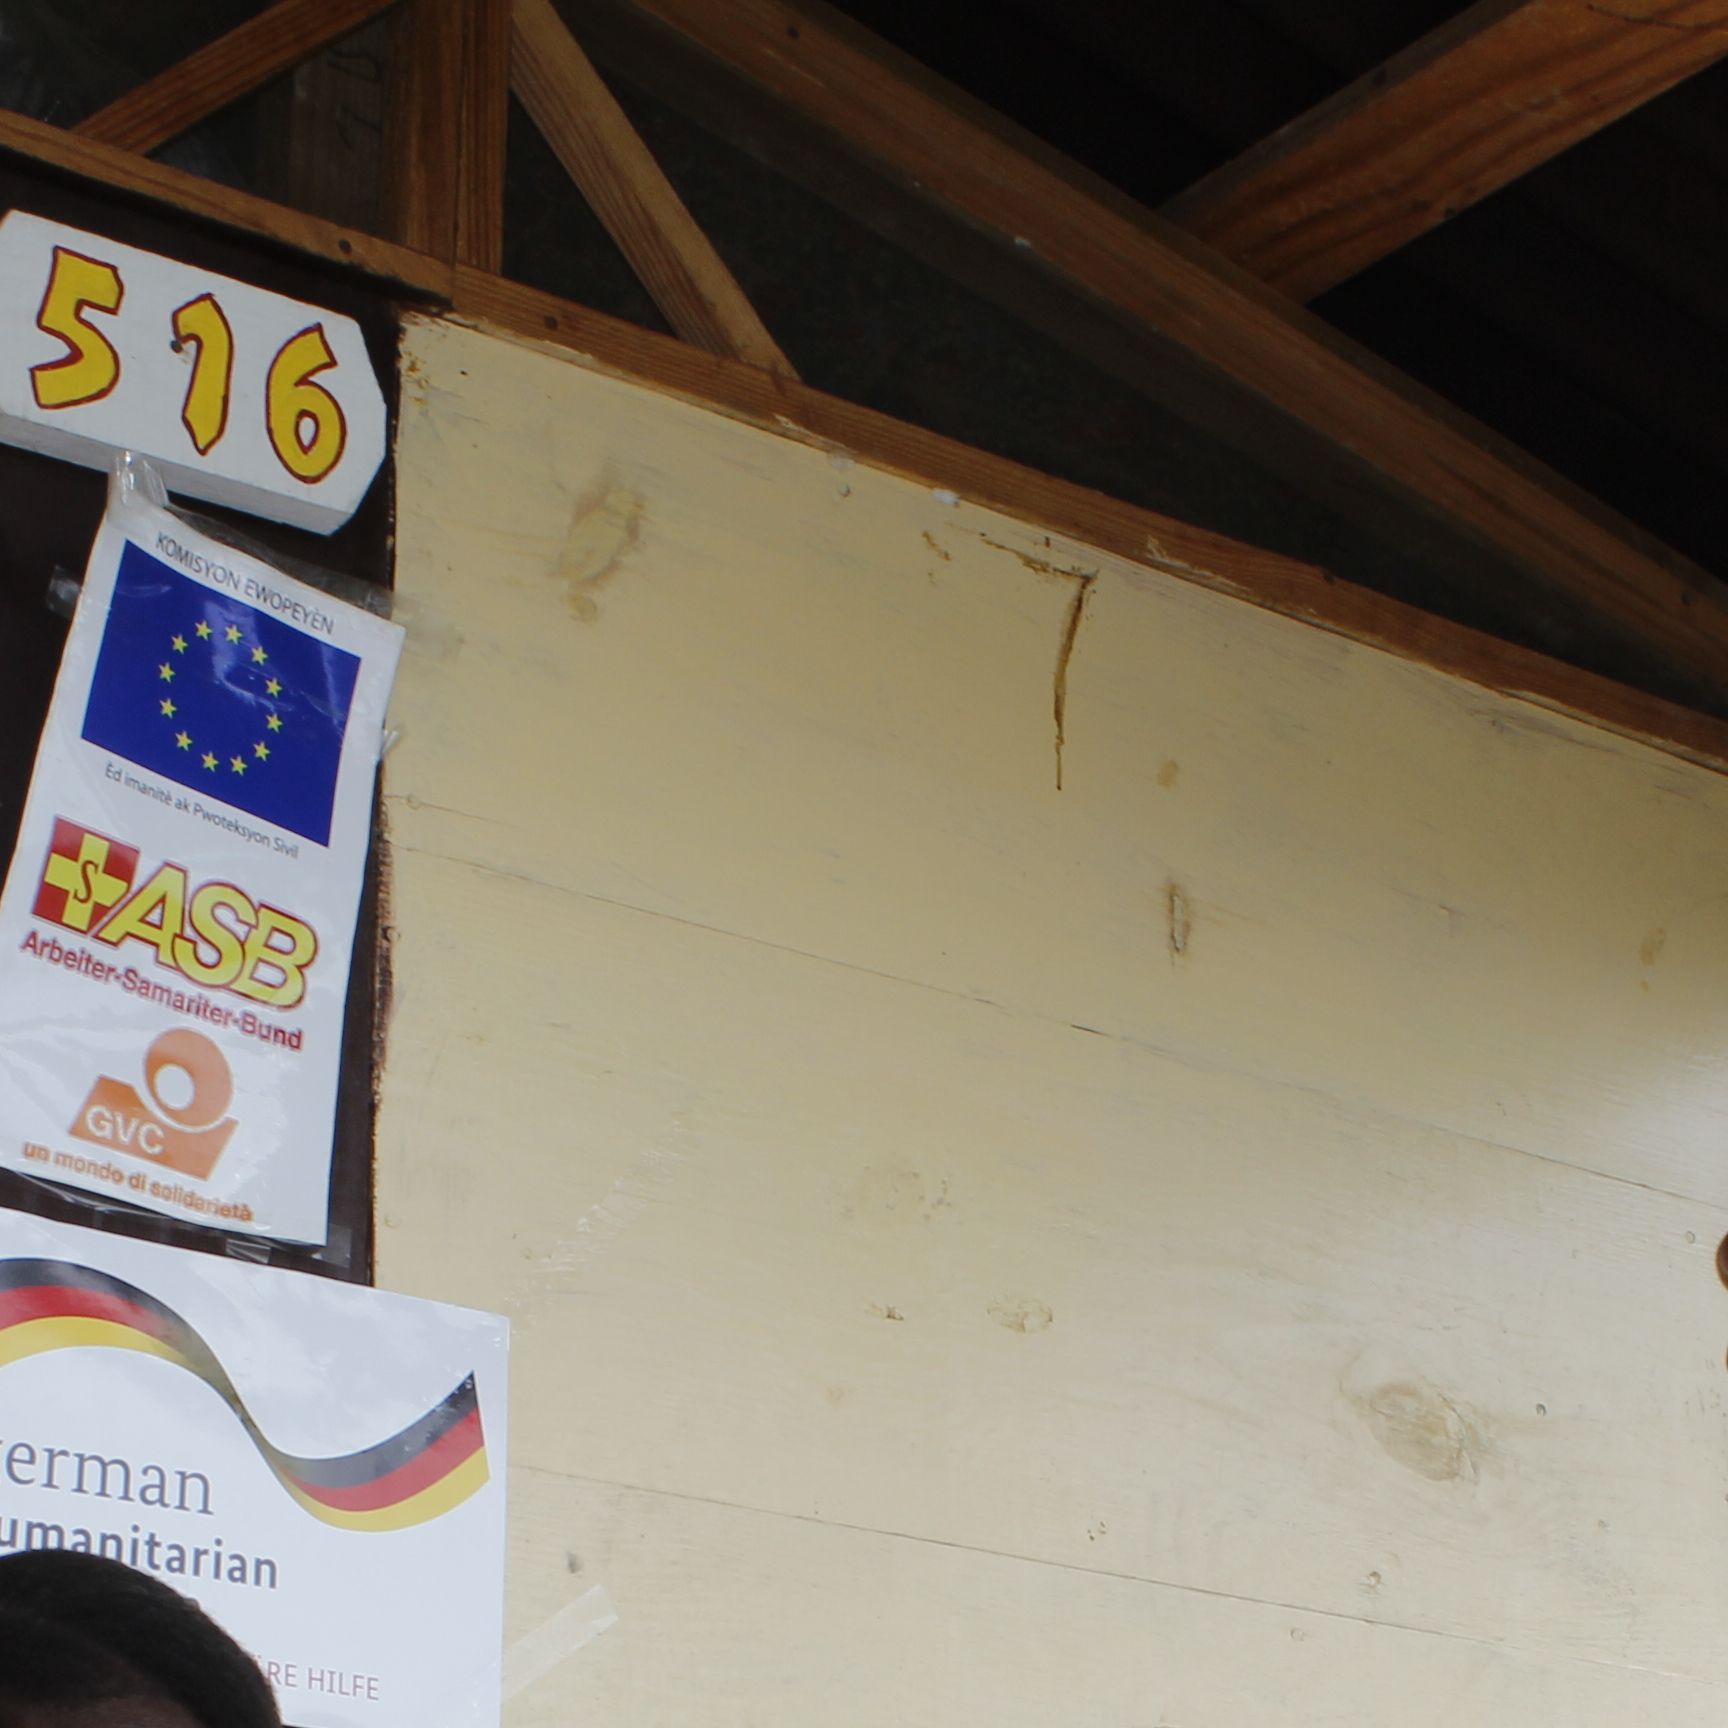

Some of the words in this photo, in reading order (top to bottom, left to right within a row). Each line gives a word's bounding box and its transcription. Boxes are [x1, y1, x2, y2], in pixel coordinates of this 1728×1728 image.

[29, 245, 348, 484] 516
[155, 531, 241, 591] KOMISYON
[174, 797, 191, 815] ak
[193, 802, 271, 848] Pwoteksyon
[273, 837, 300, 860] Sivil
[90, 861, 319, 1011] ASB
[20, 929, 304, 1051] Arbeiter-Samariter-Bund
[85, 1103, 165, 1156] GVC
[24, 1141, 50, 1163] un
[53, 1150, 124, 1185] mondo
[129, 1171, 146, 1191] di
[308, 1667, 379, 1701] HILFE
